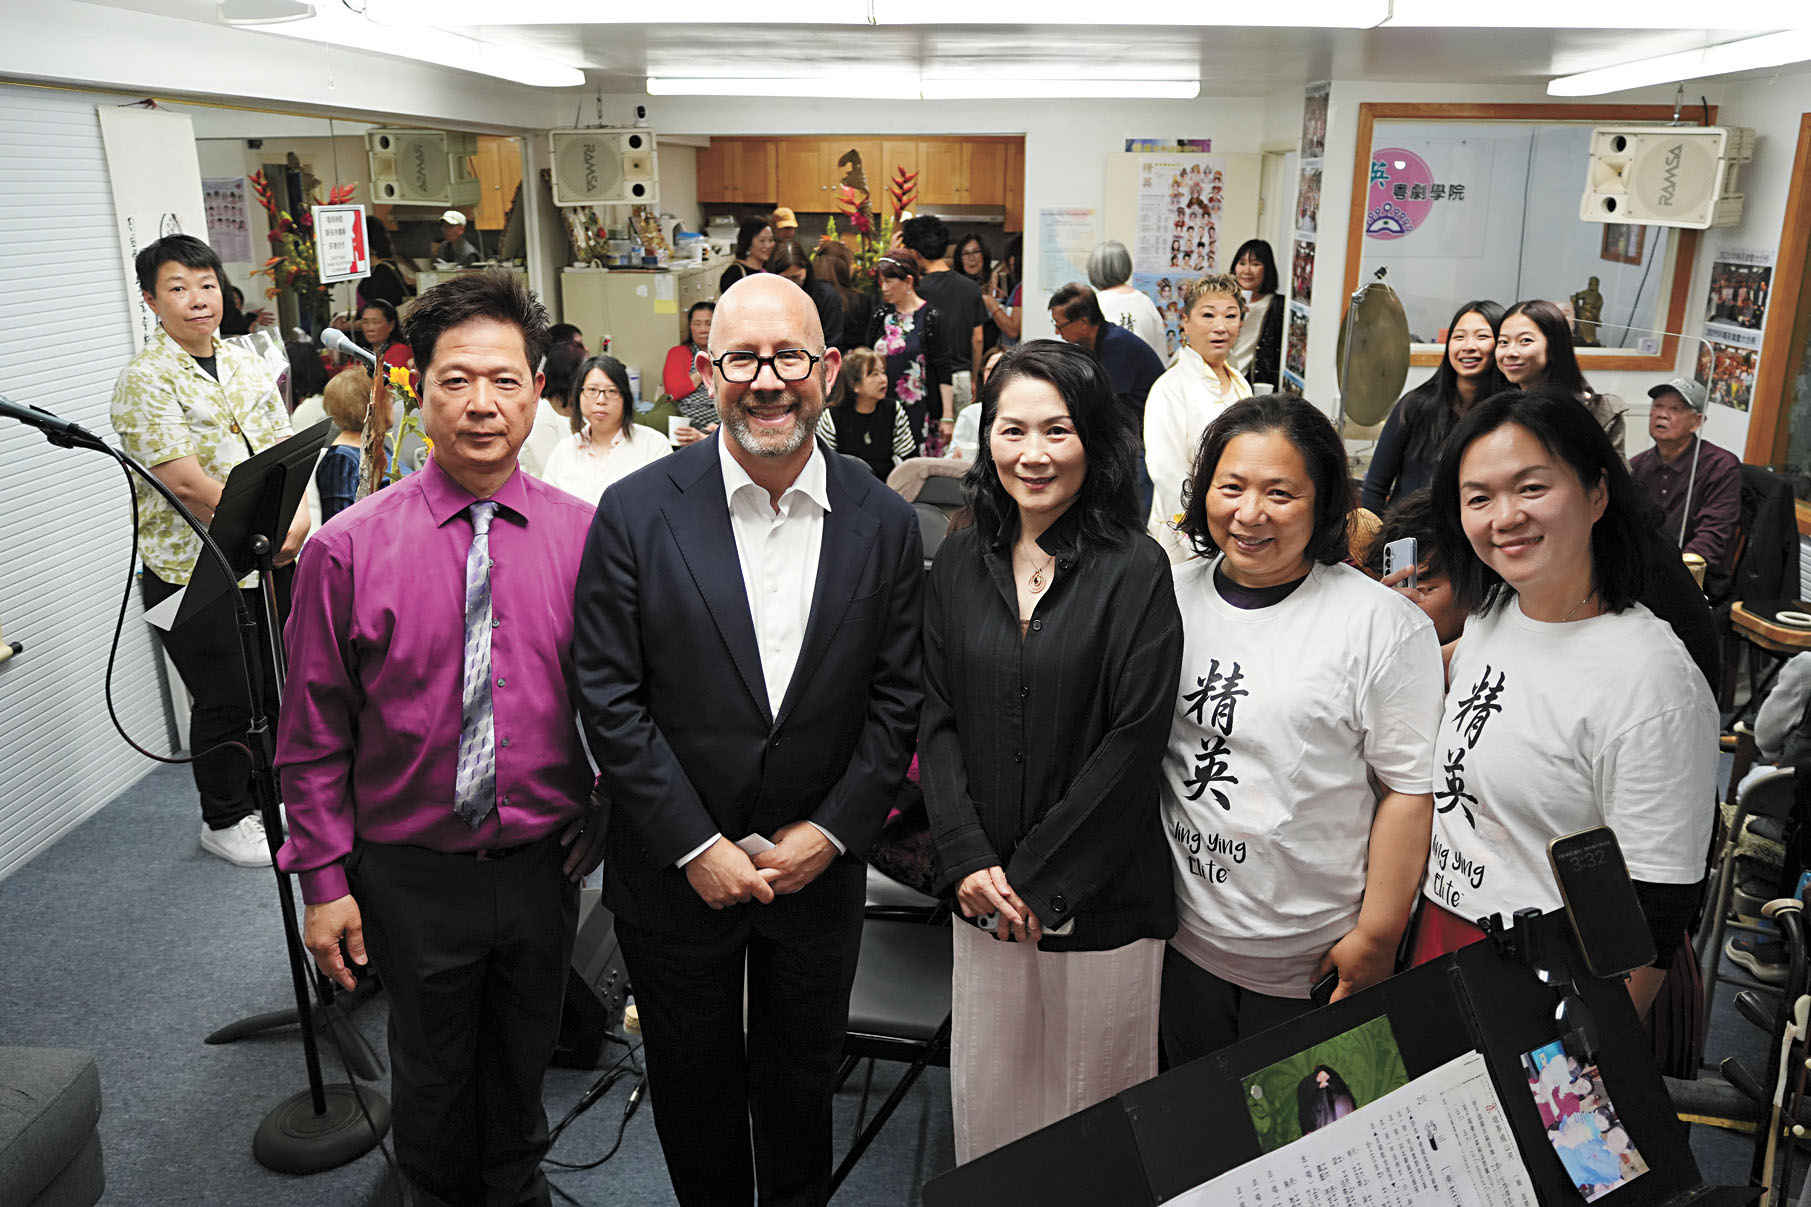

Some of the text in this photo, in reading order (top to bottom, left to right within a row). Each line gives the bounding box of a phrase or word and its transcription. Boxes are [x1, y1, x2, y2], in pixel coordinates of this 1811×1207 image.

[583, 144, 598, 194] RAMSA
[1658, 143, 1683, 206] RAMSA
[1182, 658, 1249, 811] 精英
[1434, 664, 1505, 830] 精英
[1569, 849, 1609, 872] 3:32
